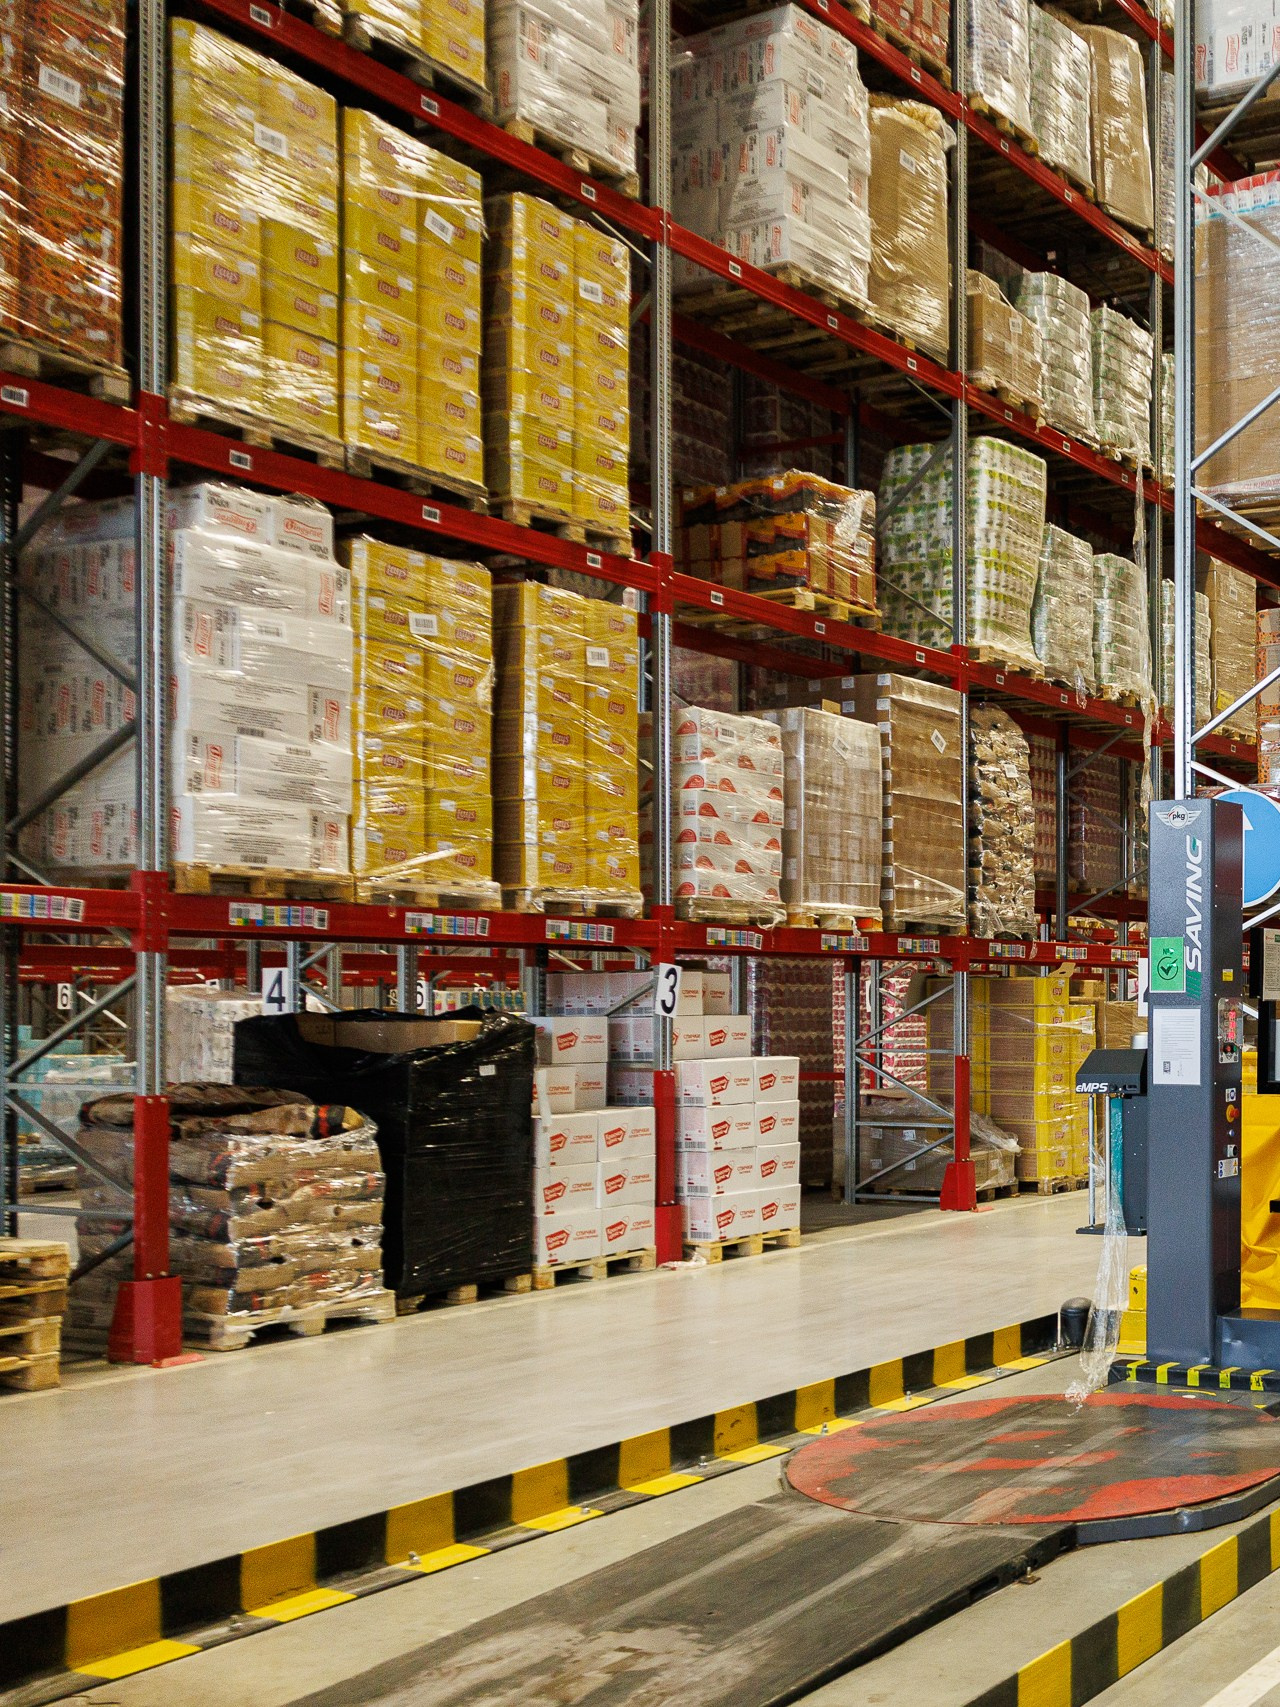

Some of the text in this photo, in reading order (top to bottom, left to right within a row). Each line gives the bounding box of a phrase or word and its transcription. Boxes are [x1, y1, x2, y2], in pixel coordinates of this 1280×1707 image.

[1172, 811, 1186, 821] pkg
[1186, 835, 1202, 972] SAVING
[60, 986, 69, 1007] 6
[266, 970, 286, 1013] 4
[661, 967, 677, 1014] 3
[1076, 1083, 1108, 1093] eMPS
